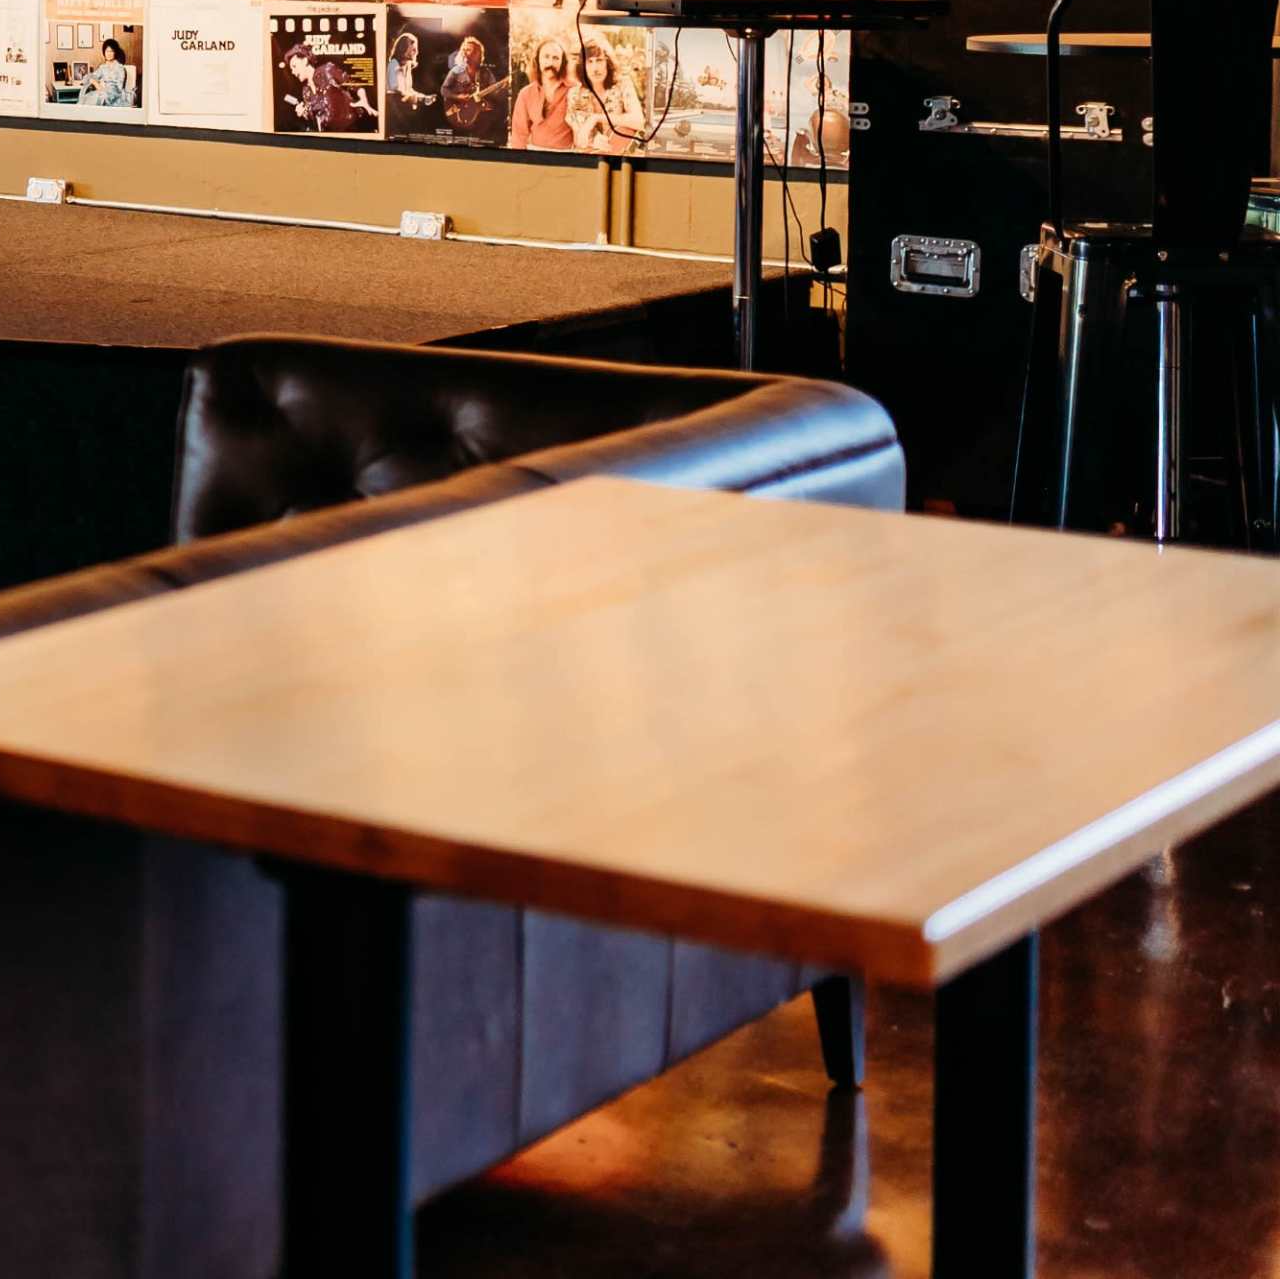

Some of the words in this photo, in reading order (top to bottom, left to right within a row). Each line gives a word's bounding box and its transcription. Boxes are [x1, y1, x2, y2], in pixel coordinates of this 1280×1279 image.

[171, 30, 199, 41] JUDY
[181, 40, 236, 51] GARLAND
[312, 43, 366, 55] GARLAND
